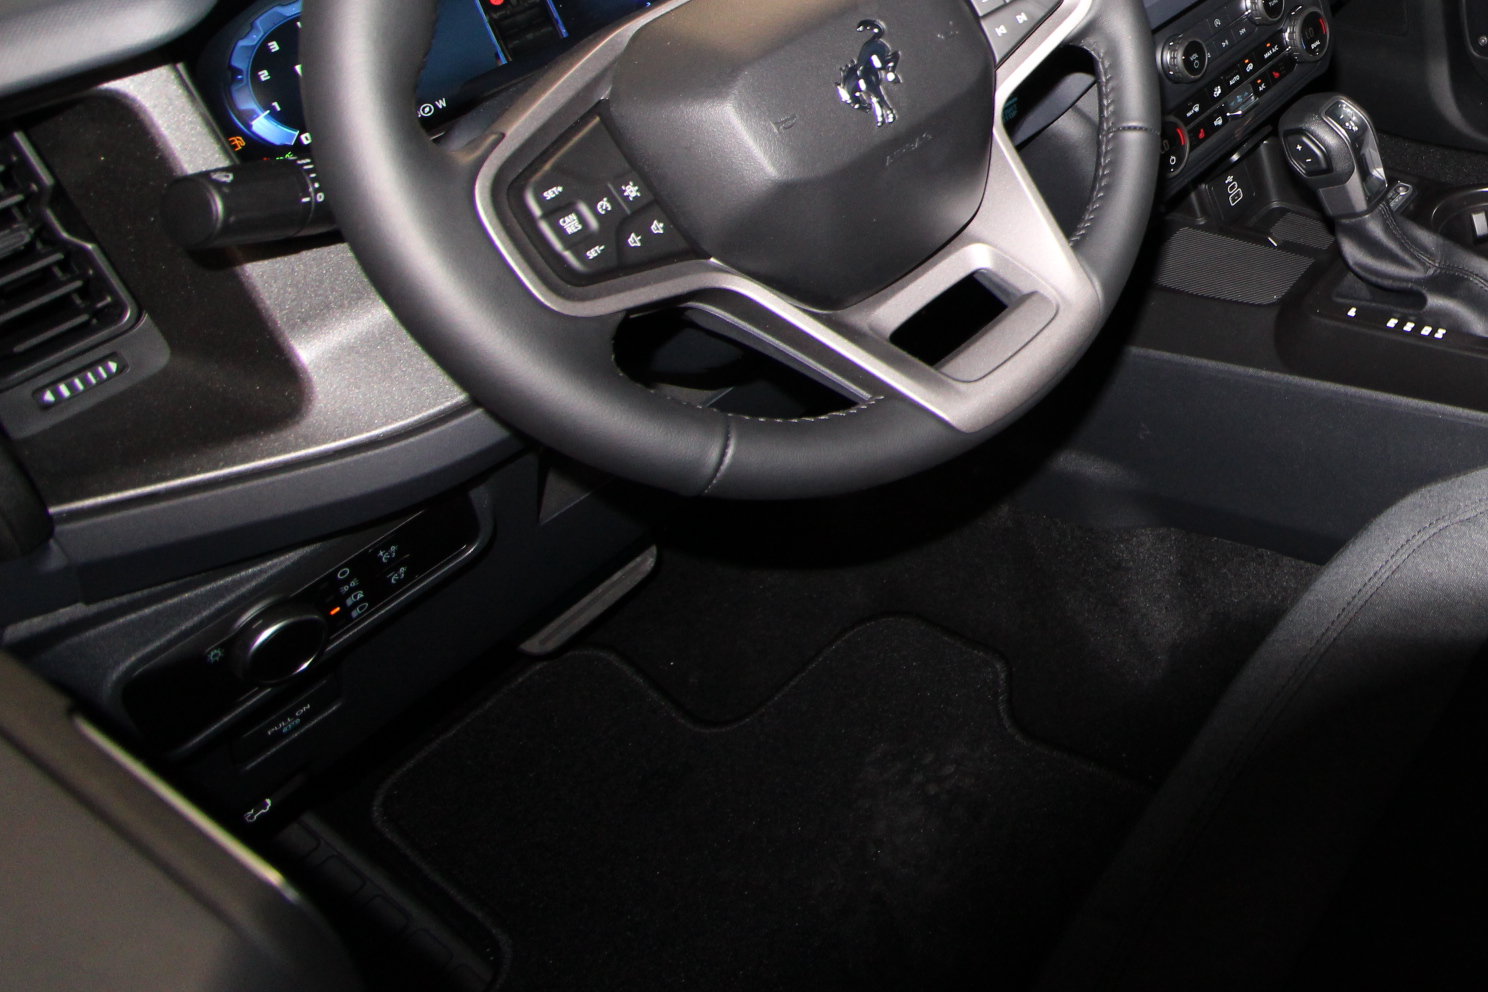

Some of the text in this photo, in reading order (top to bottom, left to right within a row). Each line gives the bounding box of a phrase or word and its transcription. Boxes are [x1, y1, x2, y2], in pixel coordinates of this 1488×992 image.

[267, 40, 280, 53] 3
[257, 69, 271, 82] 2
[271, 101, 281, 112] 1
[434, 97, 447, 109] W
[300, 132, 312, 145] 0
[542, 185, 564, 201] SET+
[558, 212, 578, 228] CAN
[564, 221, 582, 235] RES
[295, 703, 311, 717] ON
